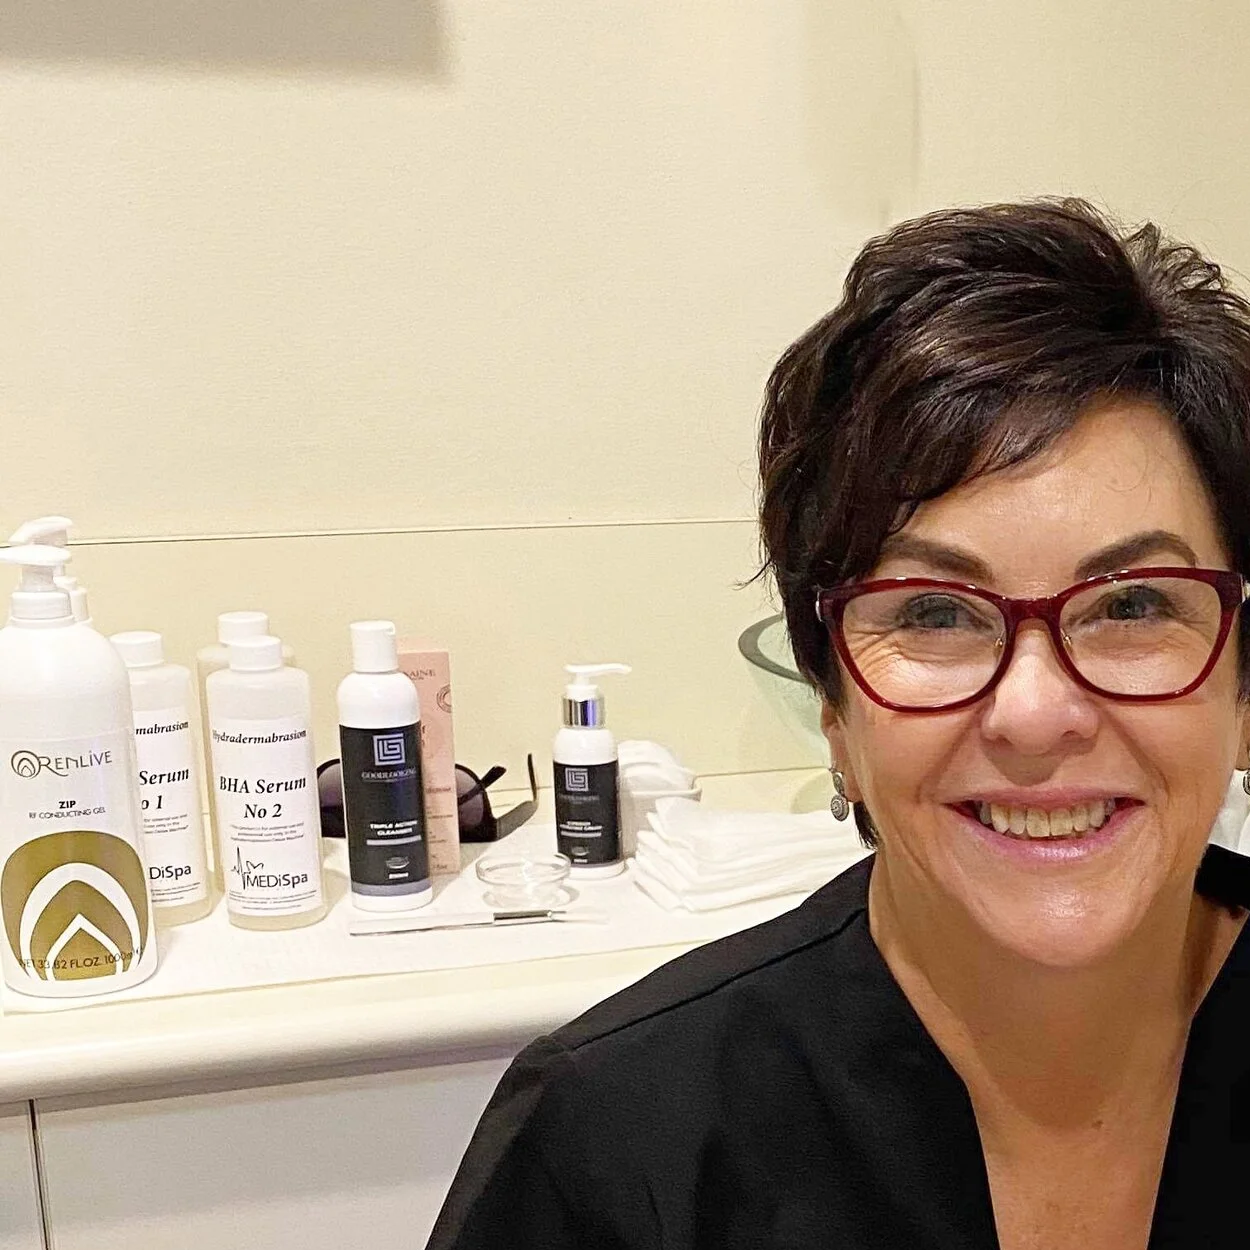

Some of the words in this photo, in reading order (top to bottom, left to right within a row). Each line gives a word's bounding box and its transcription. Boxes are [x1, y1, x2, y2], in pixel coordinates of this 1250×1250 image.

[135, 721, 189, 735] mabrasion
[139, 768, 189, 785] Serum
[219, 775, 250, 794] BHA
[255, 777, 306, 794] Serum
[58, 800, 76, 809] ZIP
[243, 803, 267, 818] No
[272, 803, 282, 818] 2
[149, 865, 192, 881] DiSpa
[246, 873, 308, 889] MEDiSpa
